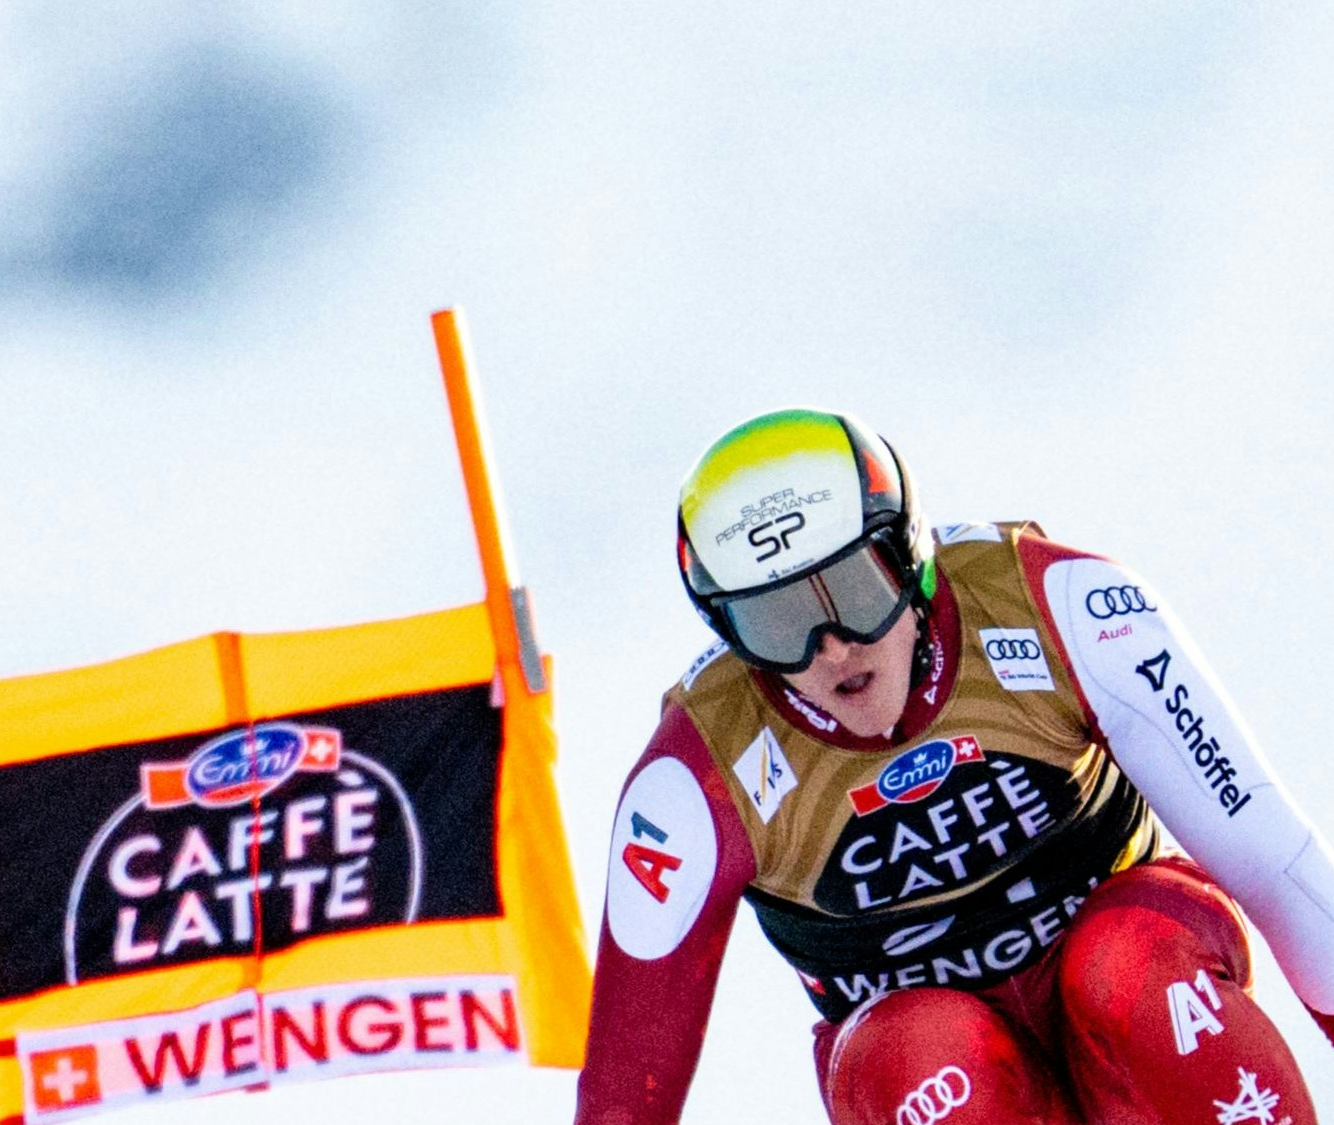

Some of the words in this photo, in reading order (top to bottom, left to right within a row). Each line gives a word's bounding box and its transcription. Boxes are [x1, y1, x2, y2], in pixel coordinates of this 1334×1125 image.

[715, 489, 833, 546] PERFORMANCE
[740, 488, 795, 517] SUPER
[747, 511, 805, 563] SP
[1097, 624, 1133, 643] Audi
[194, 738, 296, 785] Emmi
[883, 750, 947, 790] Emmi
[1165, 684, 1252, 818] Schöffel
[108, 773, 379, 898] CAFFÈ
[622, 811, 683, 904] A1
[841, 760, 1041, 875] CAFFÈ
[854, 802, 1057, 909] LATTE
[112, 858, 370, 963] LATTE
[125, 989, 522, 1094] WENGEN
[1166, 969, 1225, 1055] A1
